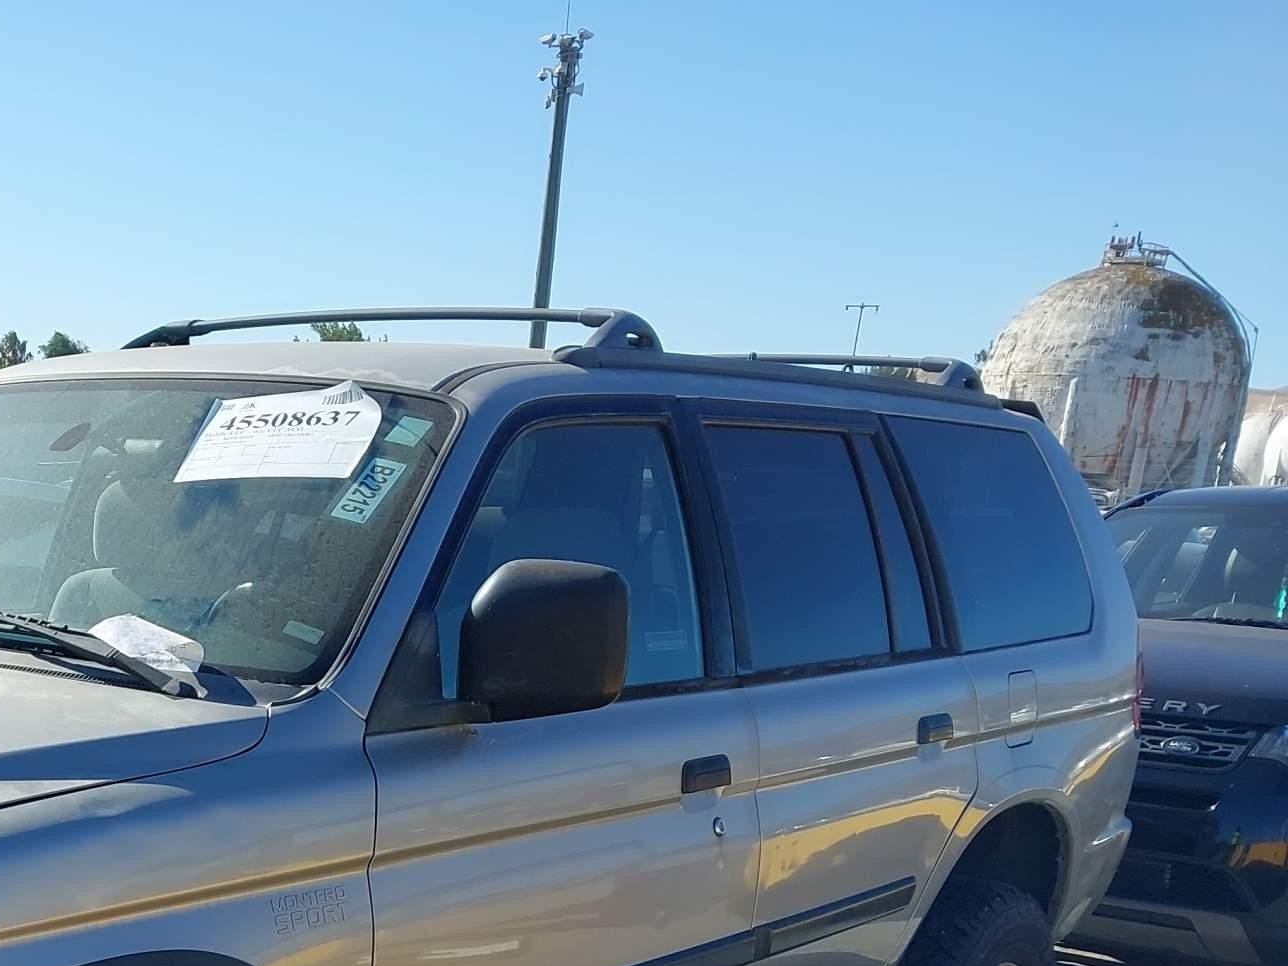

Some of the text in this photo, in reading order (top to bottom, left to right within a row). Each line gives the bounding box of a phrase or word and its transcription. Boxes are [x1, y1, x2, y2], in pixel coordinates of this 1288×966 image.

[220, 410, 361, 432] 45508637
[340, 464, 396, 516] B22215
[270, 885, 345, 913] MONTERO
[274, 901, 347, 936] SPORT
